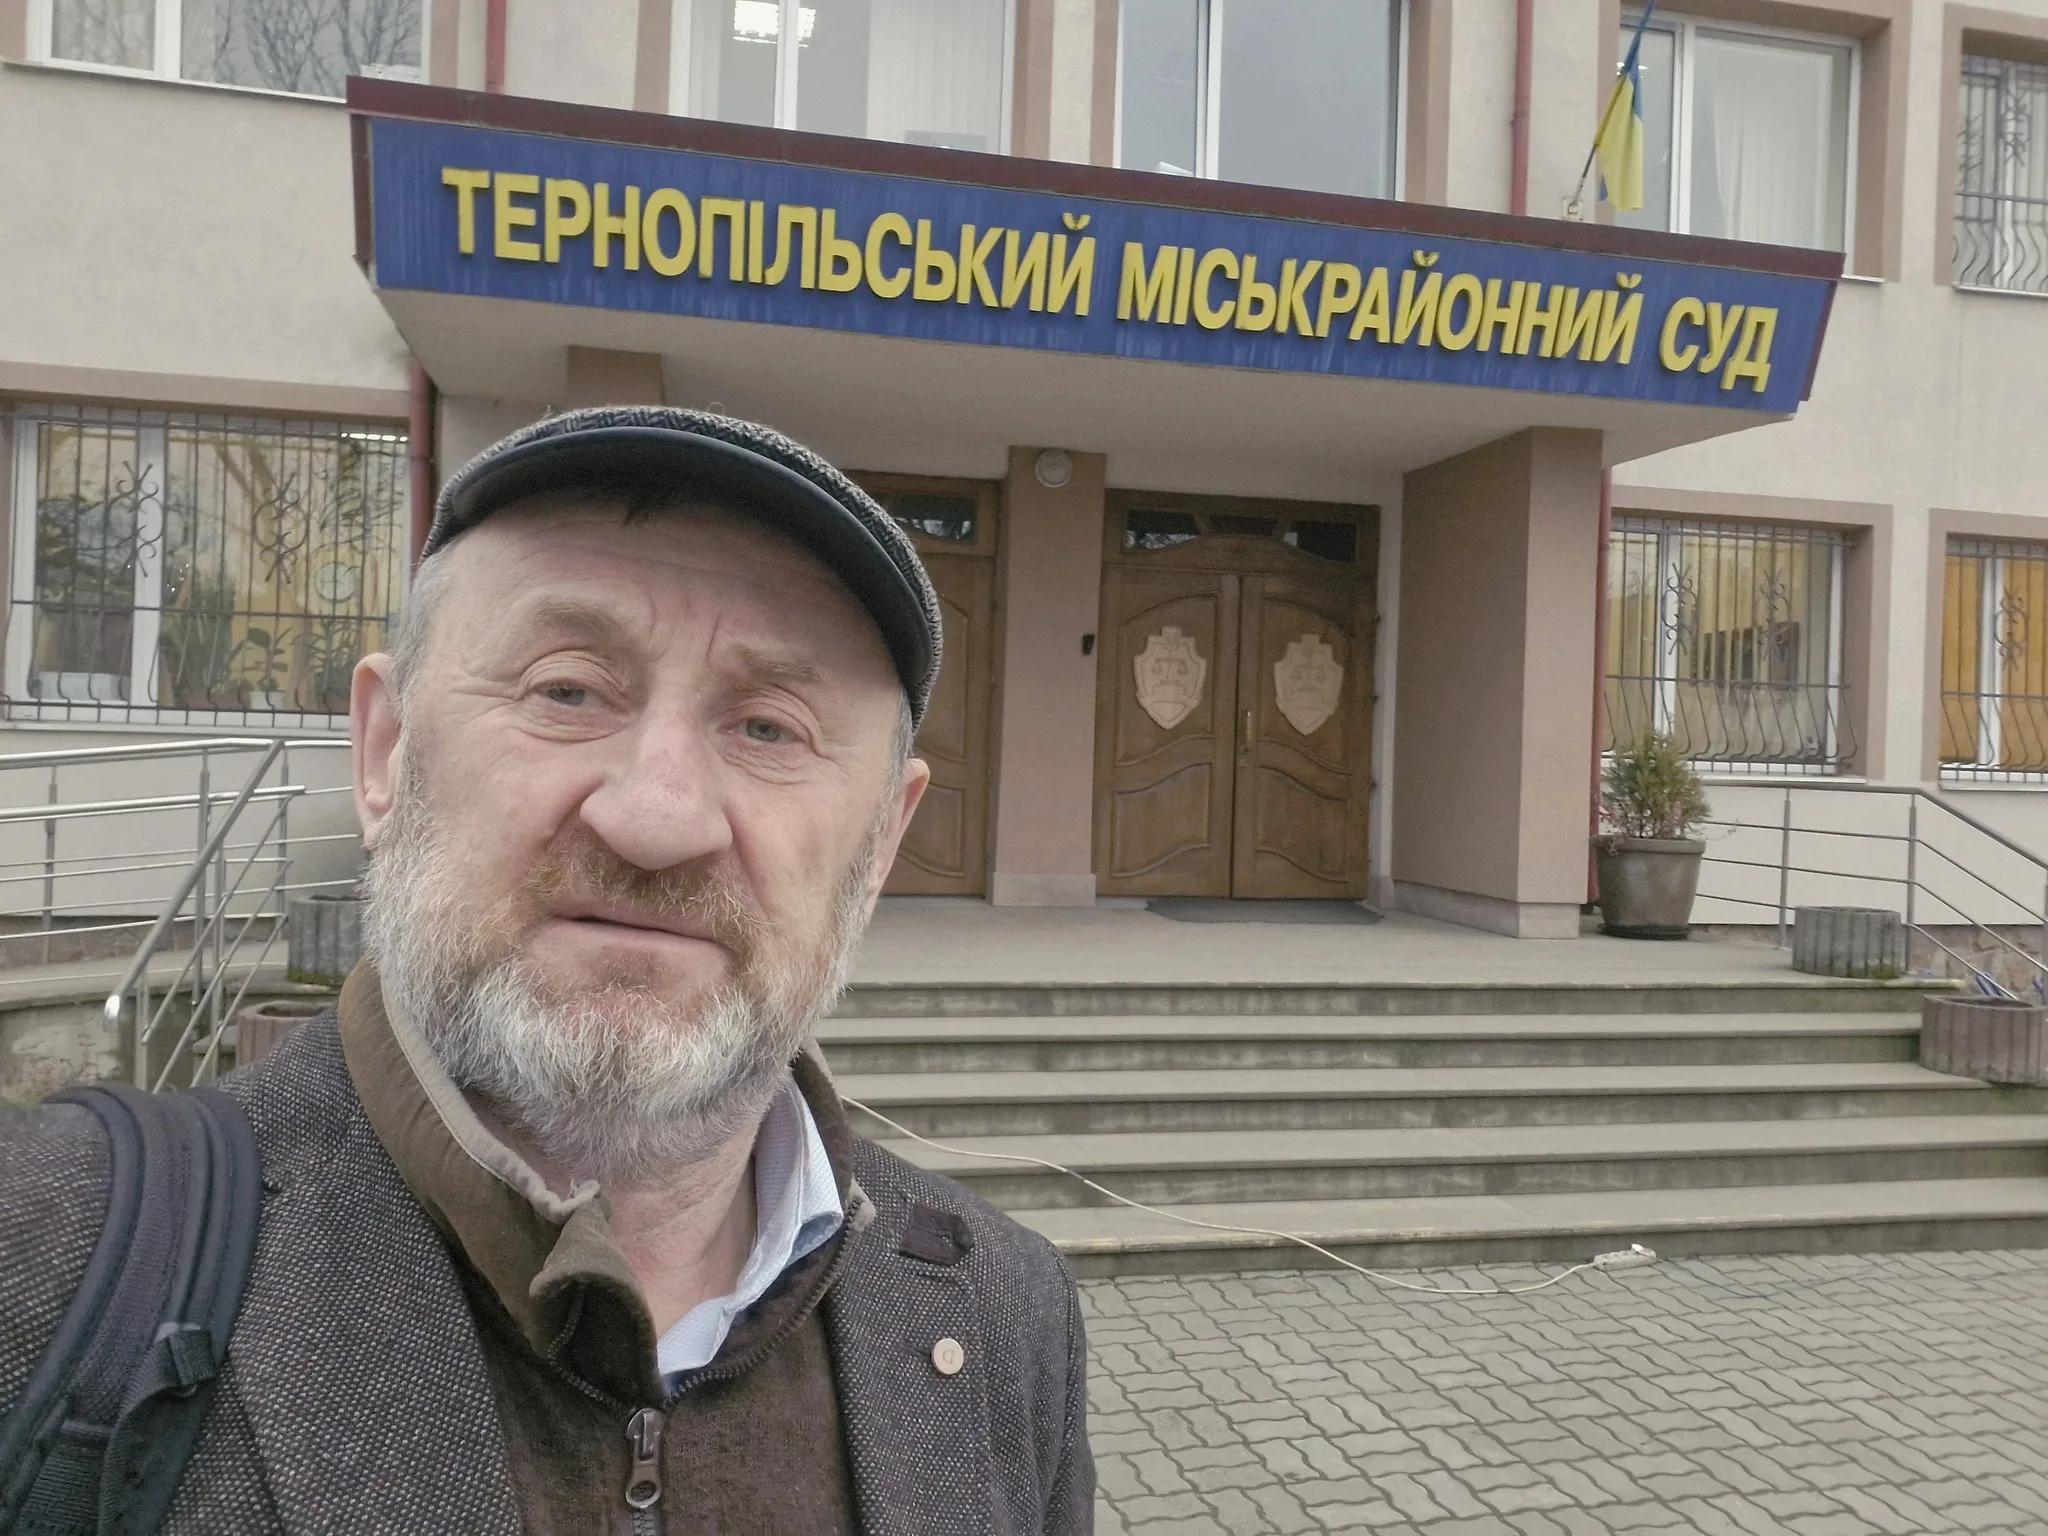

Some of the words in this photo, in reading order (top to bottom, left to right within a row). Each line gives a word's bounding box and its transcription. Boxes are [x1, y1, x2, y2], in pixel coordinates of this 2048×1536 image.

[441, 167, 1094, 317] ТЕРНОПІЛЬСЬКИЙ
[1117, 241, 1643, 365] МІСЬКРАЙОННИЙ
[1658, 297, 1778, 393] СУД
